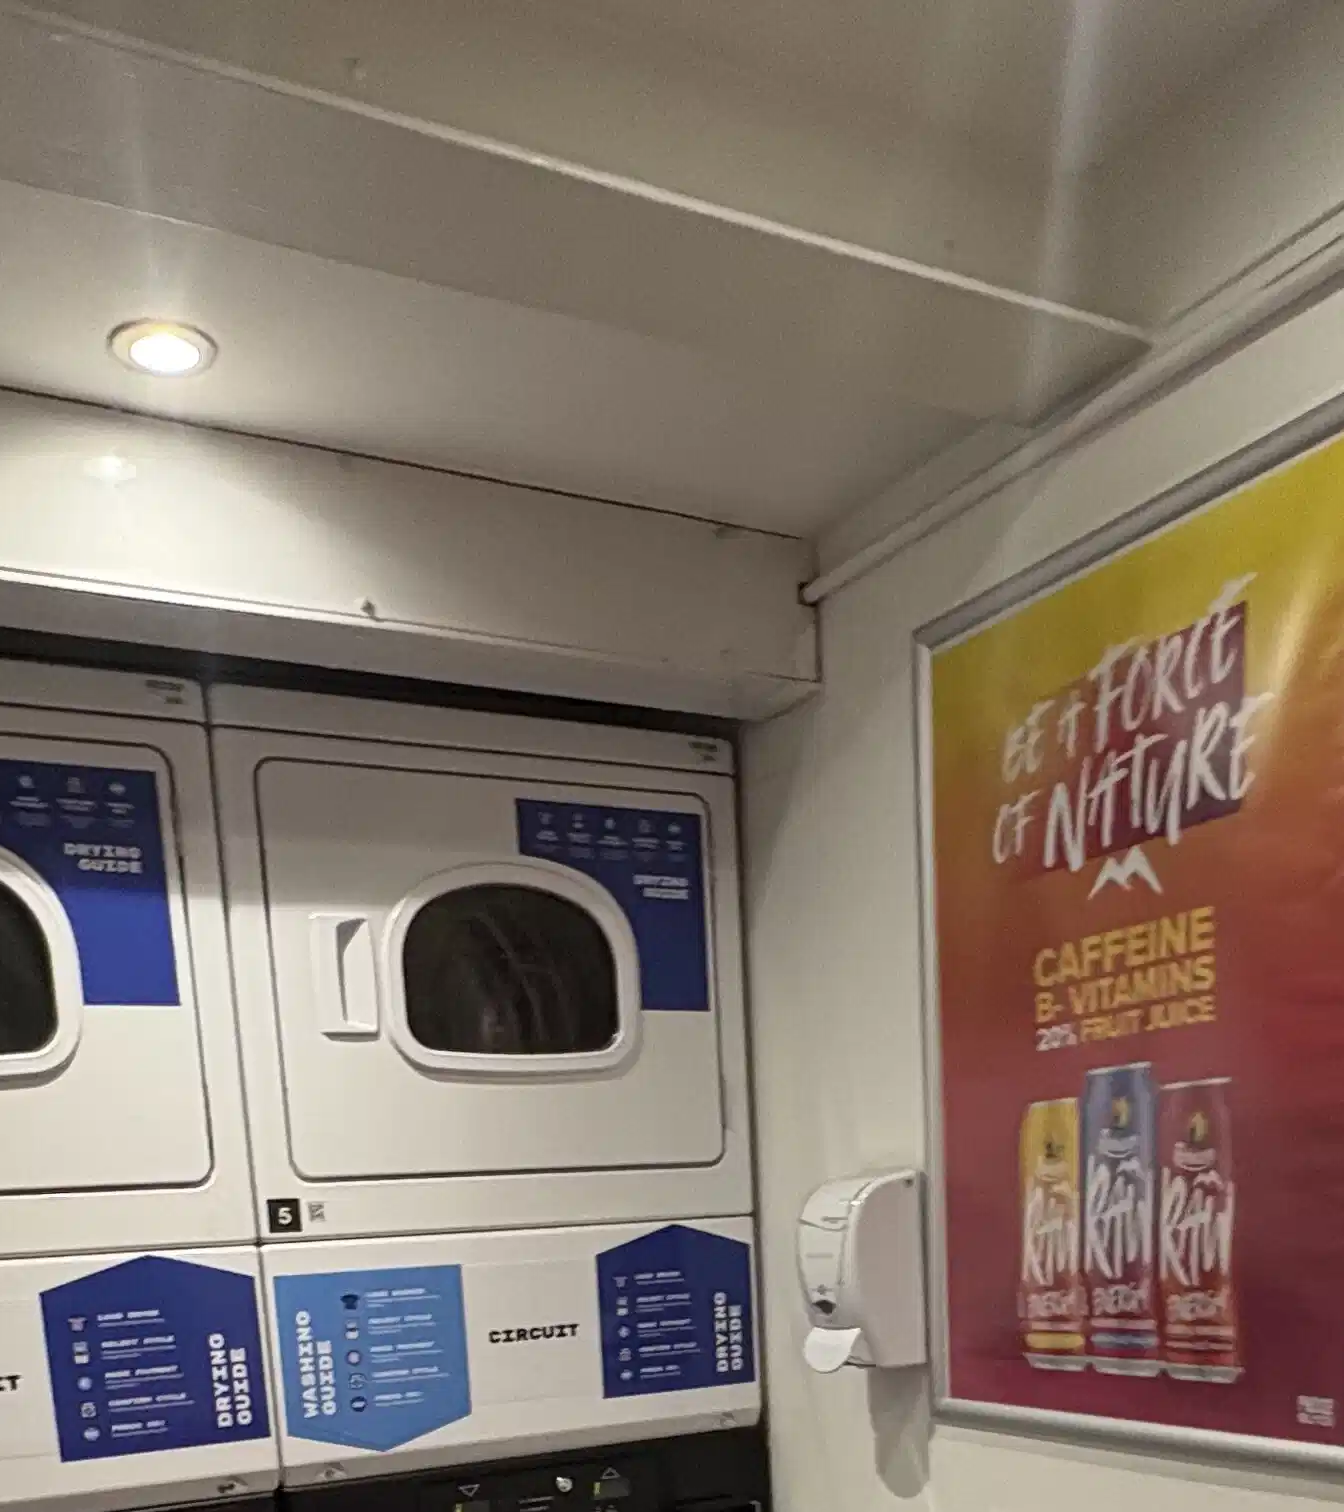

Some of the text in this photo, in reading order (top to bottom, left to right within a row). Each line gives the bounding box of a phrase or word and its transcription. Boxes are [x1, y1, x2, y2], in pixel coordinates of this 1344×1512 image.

[1001, 700, 1058, 783] BE
[1088, 571, 1258, 754] FORCE
[1043, 692, 1276, 873] NATURE
[1032, 905, 1217, 988] CAFFEINE
[1067, 955, 1217, 1015] VITAMINS
[1079, 1008, 1145, 1043] FRUIT
[1144, 994, 1218, 1032] JUICE
[277, 1206, 294, 1226] 5
[295, 1310, 320, 1420] WASHING
[487, 1321, 581, 1345] CIRCUIT
[713, 1291, 730, 1374] DRYING
[208, 1332, 235, 1430] DRYING
[229, 1347, 253, 1426] GUIDE
[316, 1340, 338, 1417] GUIDE
